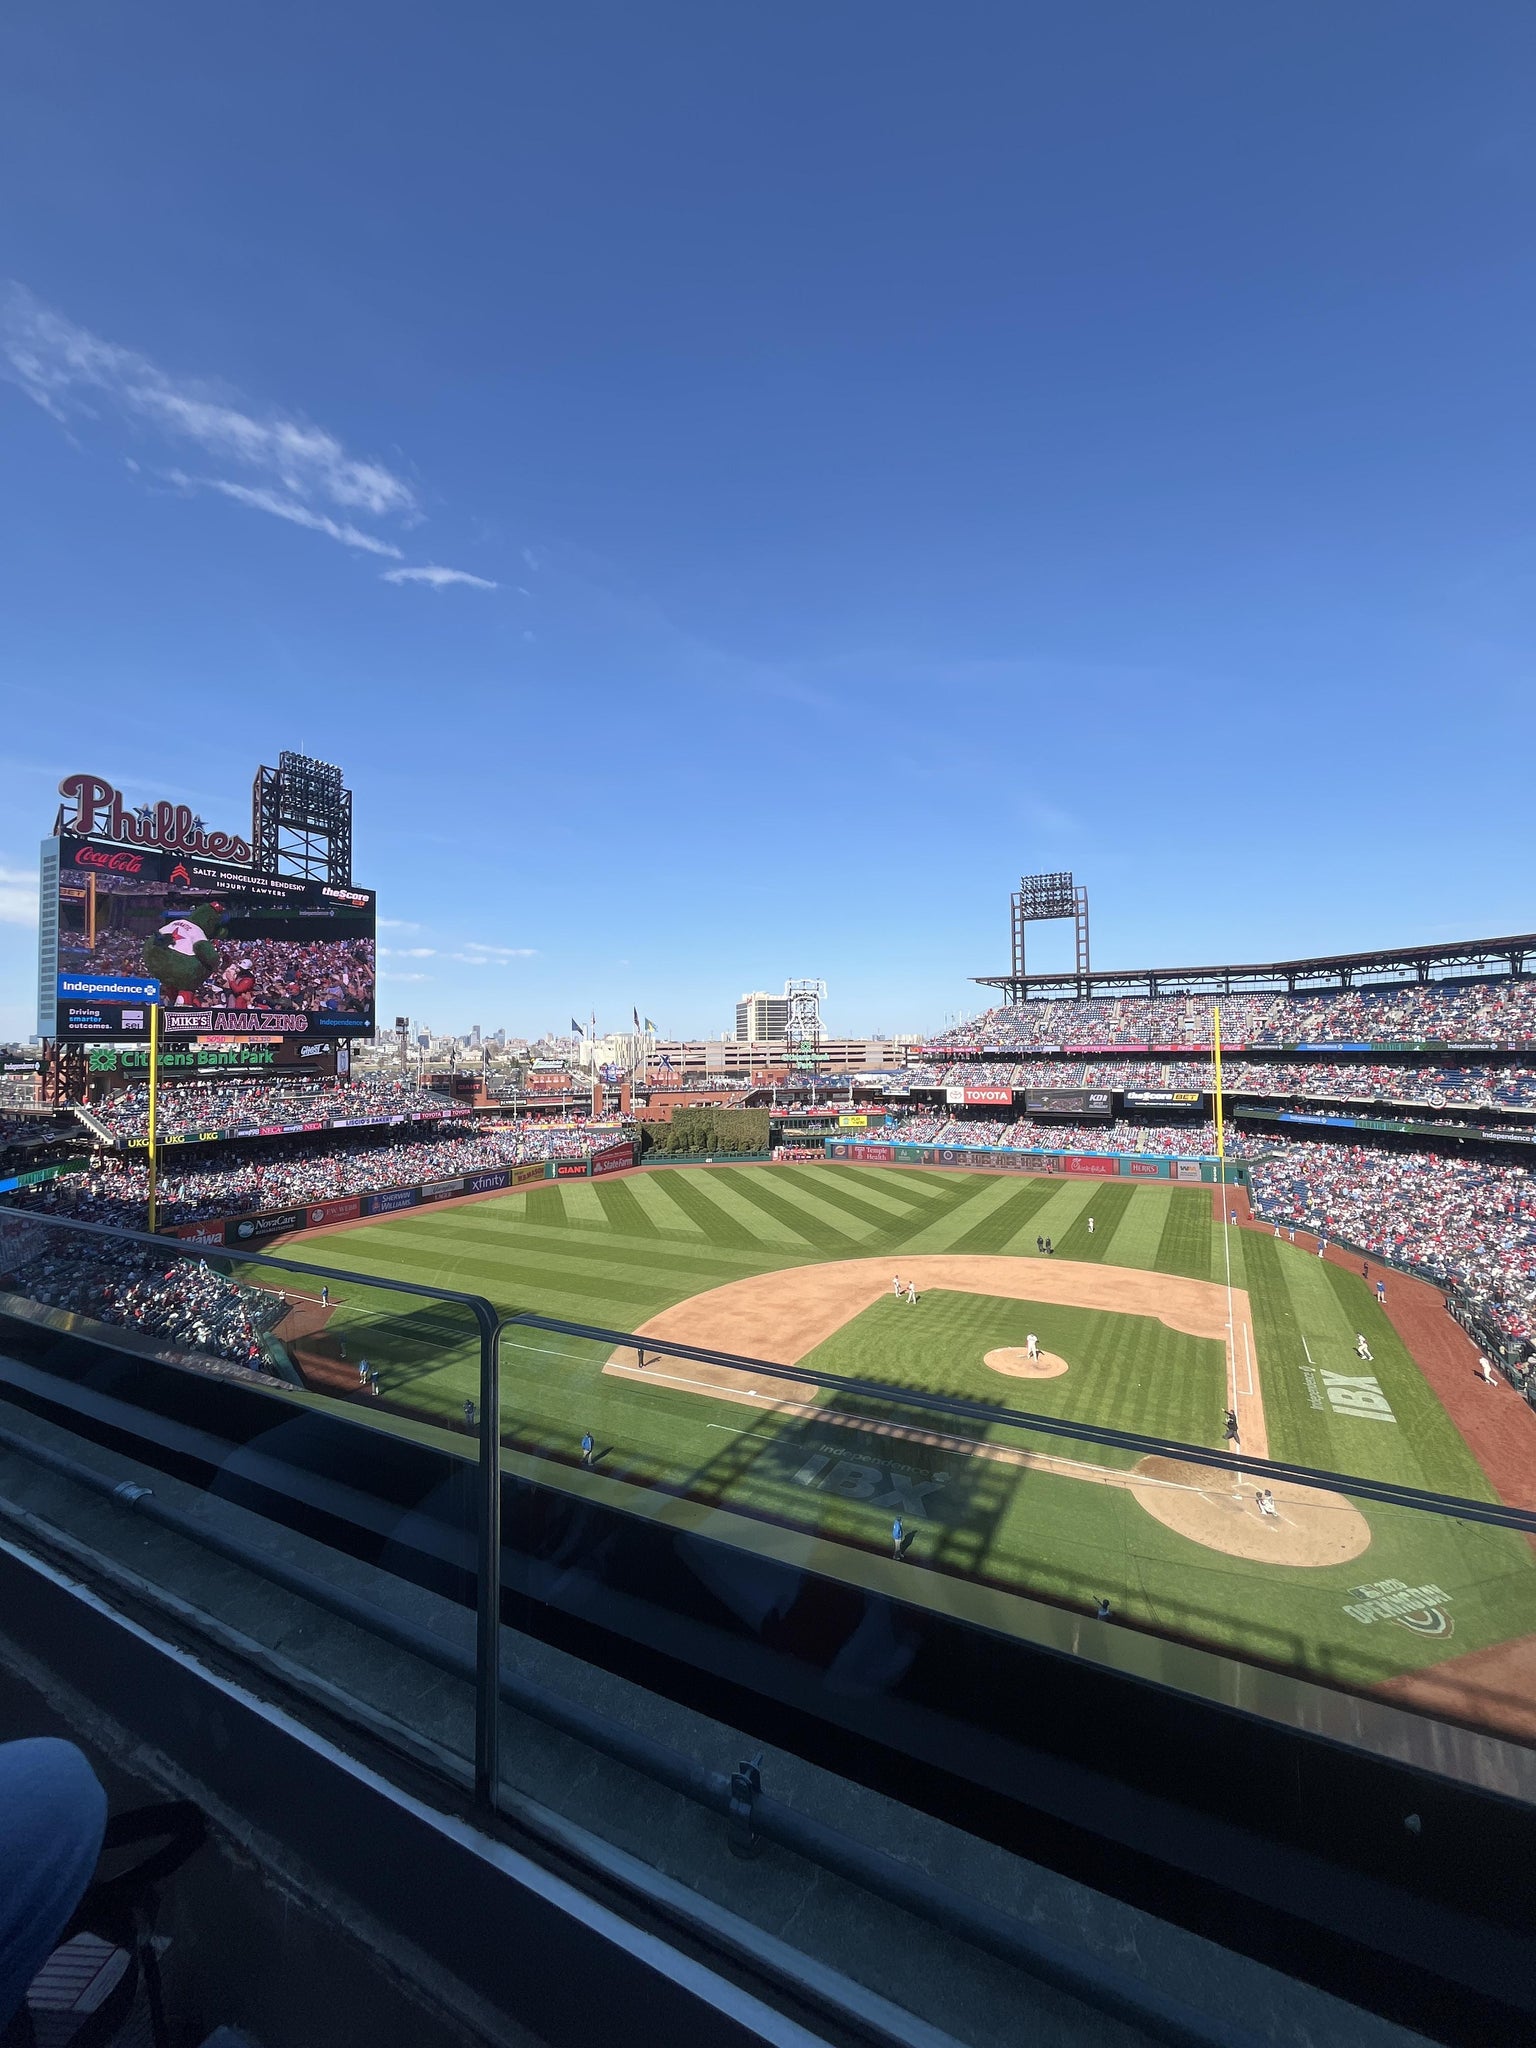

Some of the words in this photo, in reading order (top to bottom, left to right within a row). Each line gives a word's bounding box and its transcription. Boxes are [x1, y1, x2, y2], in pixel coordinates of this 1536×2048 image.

[59, 774, 252, 863] Phillies
[193, 867, 217, 878] SALTZ
[220, 872, 268, 886] MONGELUZZI
[270, 880, 306, 892] BENDESKY
[216, 881, 247, 891] INJURY
[252, 887, 286, 897] LAWYERS
[322, 887, 370, 902] theScore
[63, 981, 143, 994] Independence
[69, 1008, 100, 1017] Driving
[171, 1015, 208, 1027] MIKE'S
[214, 1012, 309, 1032] AMAZING
[319, 1018, 364, 1027] Independence
[121, 1050, 194, 1067] Citzens
[197, 1050, 238, 1065] Bank
[240, 1049, 274, 1064] Park
[966, 1091, 1008, 1100] TOYOTA
[1127, 1092, 1173, 1101] theScore
[371, 1116, 393, 1124] BAKERY
[128, 1138, 150, 1148] UKG
[165, 1135, 185, 1144] UKG
[199, 1132, 218, 1141] UKG
[1482, 1131, 1531, 1142] Independence
[558, 1165, 587, 1174] GIANT
[472, 1175, 505, 1191] xfinity
[255, 1215, 297, 1230] NovaCare
[1320, 1368, 1398, 1424] IBX
[819, 1444, 931, 1478] Independence
[791, 1453, 946, 1517] IBX
[1342, 1591, 1426, 1624] OPENING
[1406, 1583, 1454, 1607] DAY
